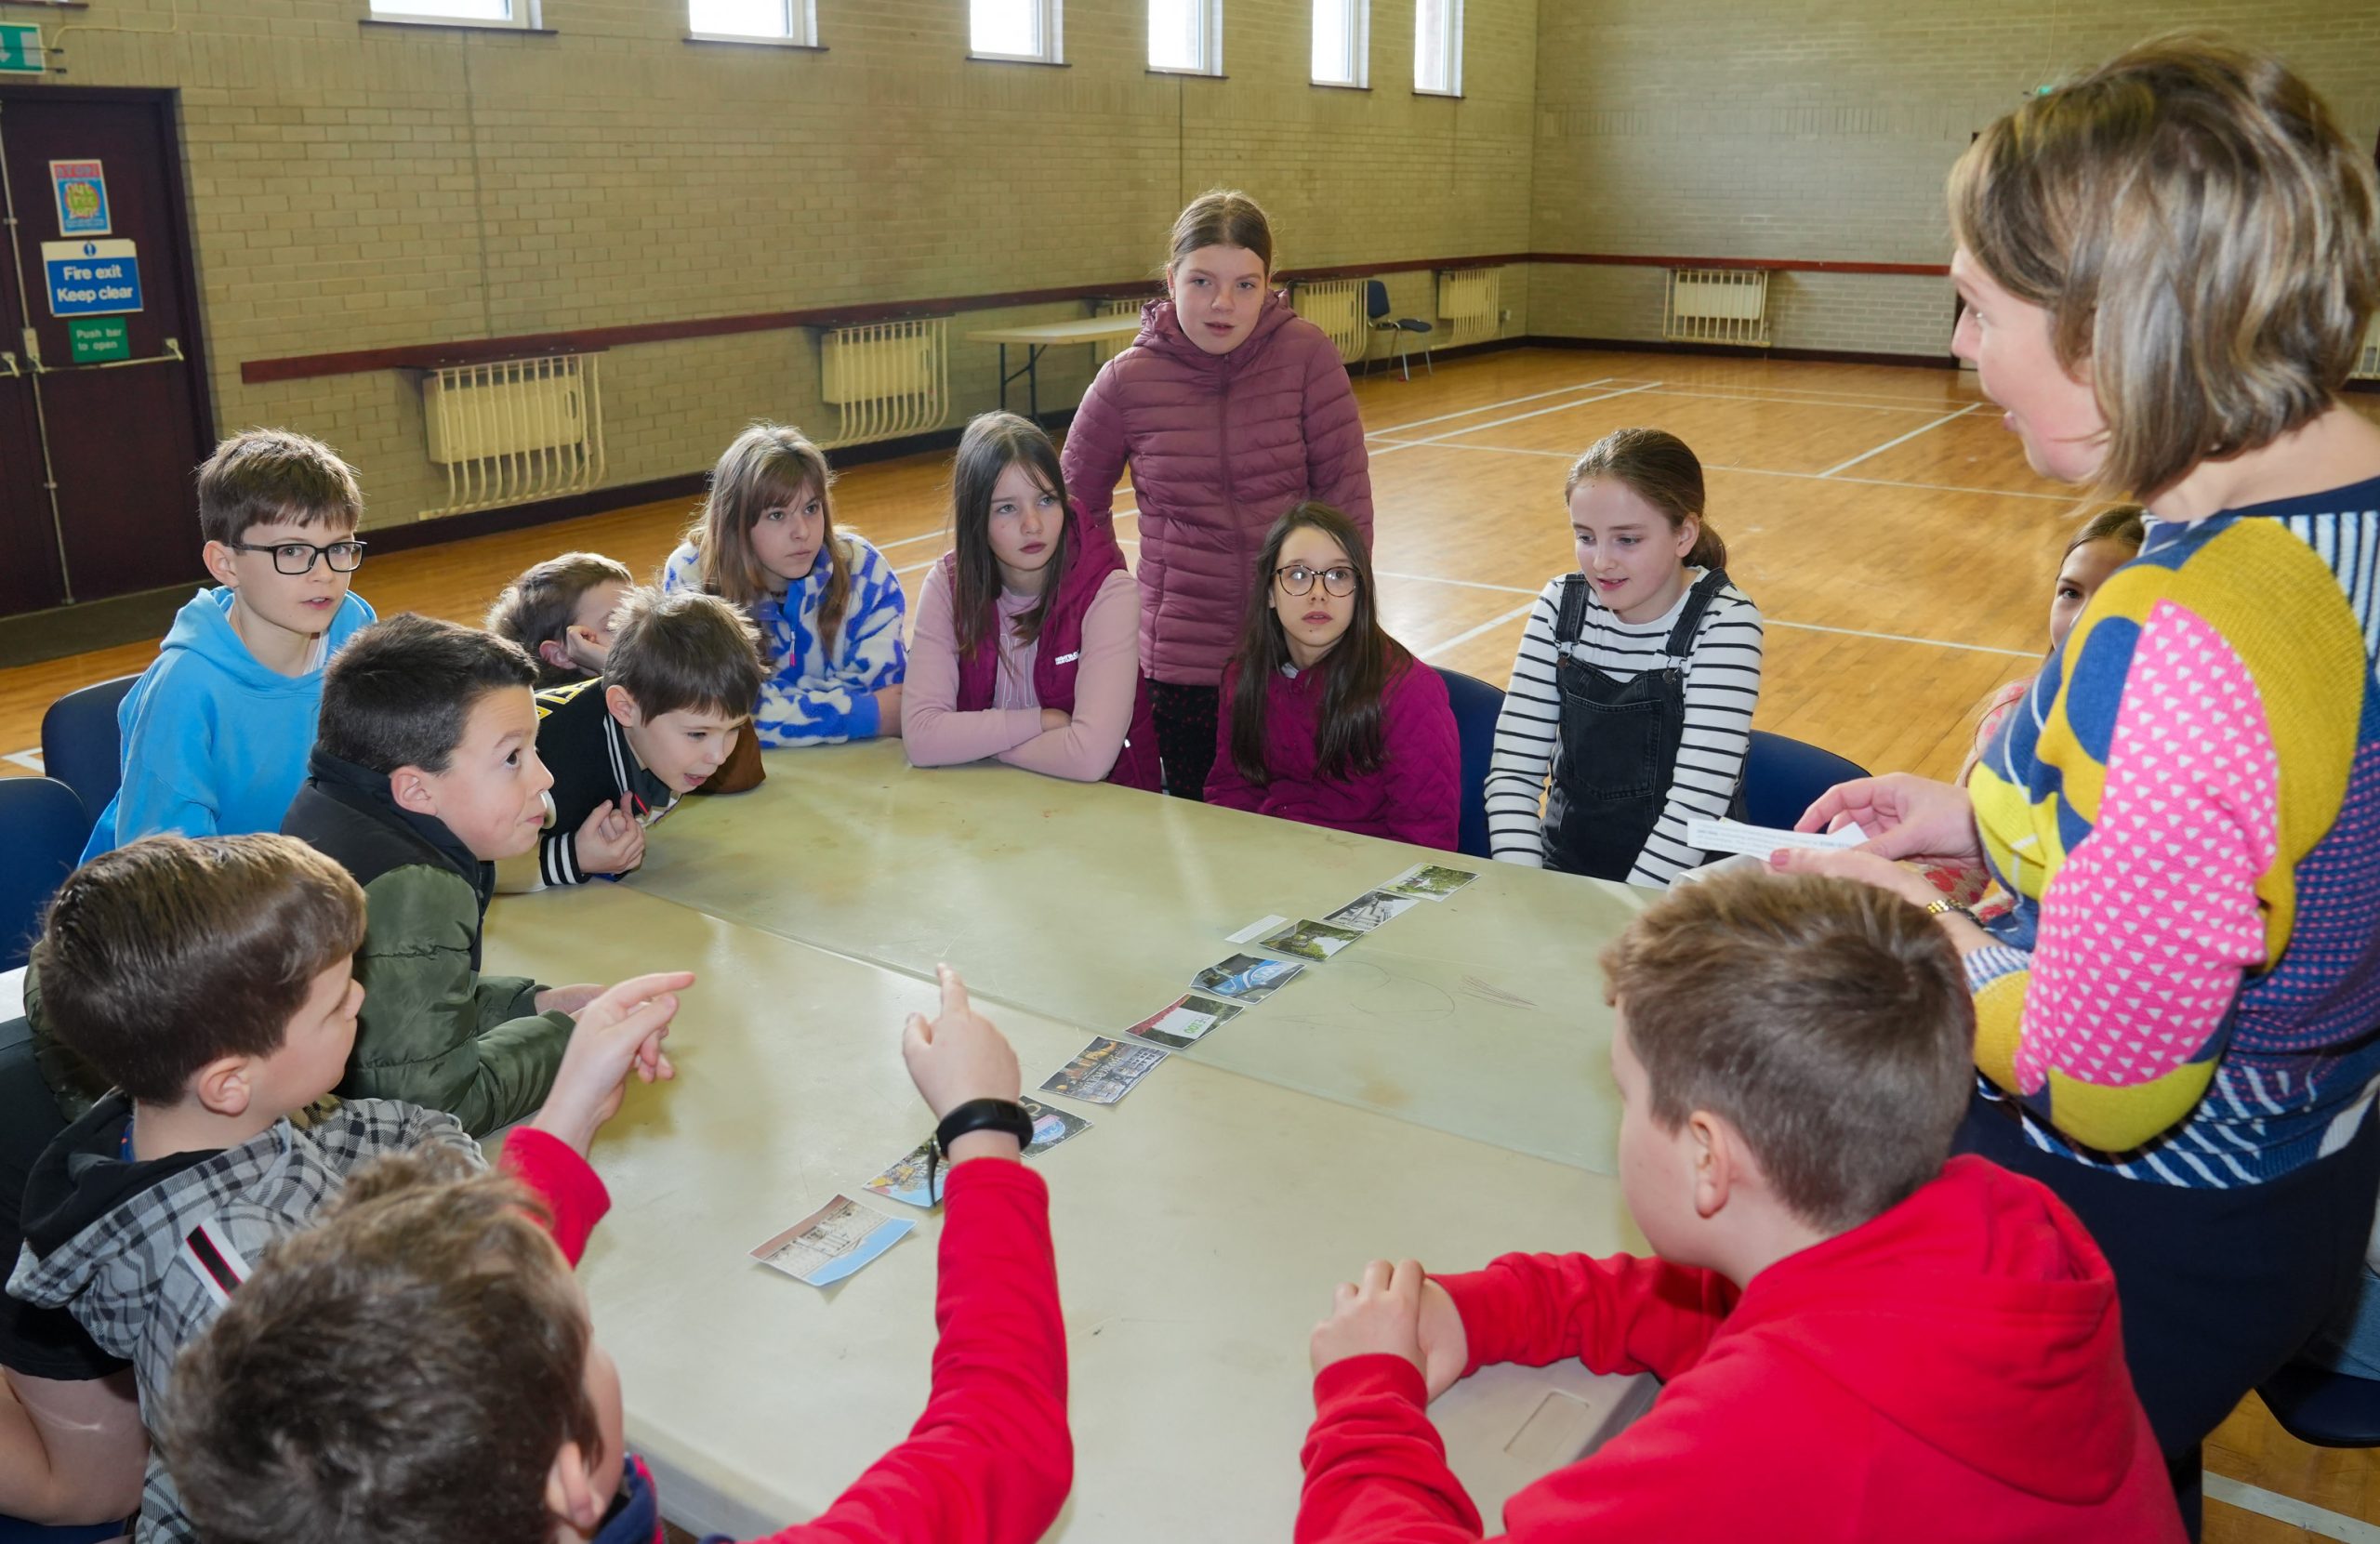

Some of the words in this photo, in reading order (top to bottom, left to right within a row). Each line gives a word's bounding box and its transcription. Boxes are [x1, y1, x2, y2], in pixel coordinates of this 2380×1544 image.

[63, 266, 92, 281] Fire
[95, 264, 123, 279] exit
[57, 287, 97, 303] Keep
[99, 285, 133, 300] clear
[76, 329, 102, 339] Push
[106, 328, 122, 337] bar
[78, 342, 89, 351] to
[93, 341, 118, 351] open
